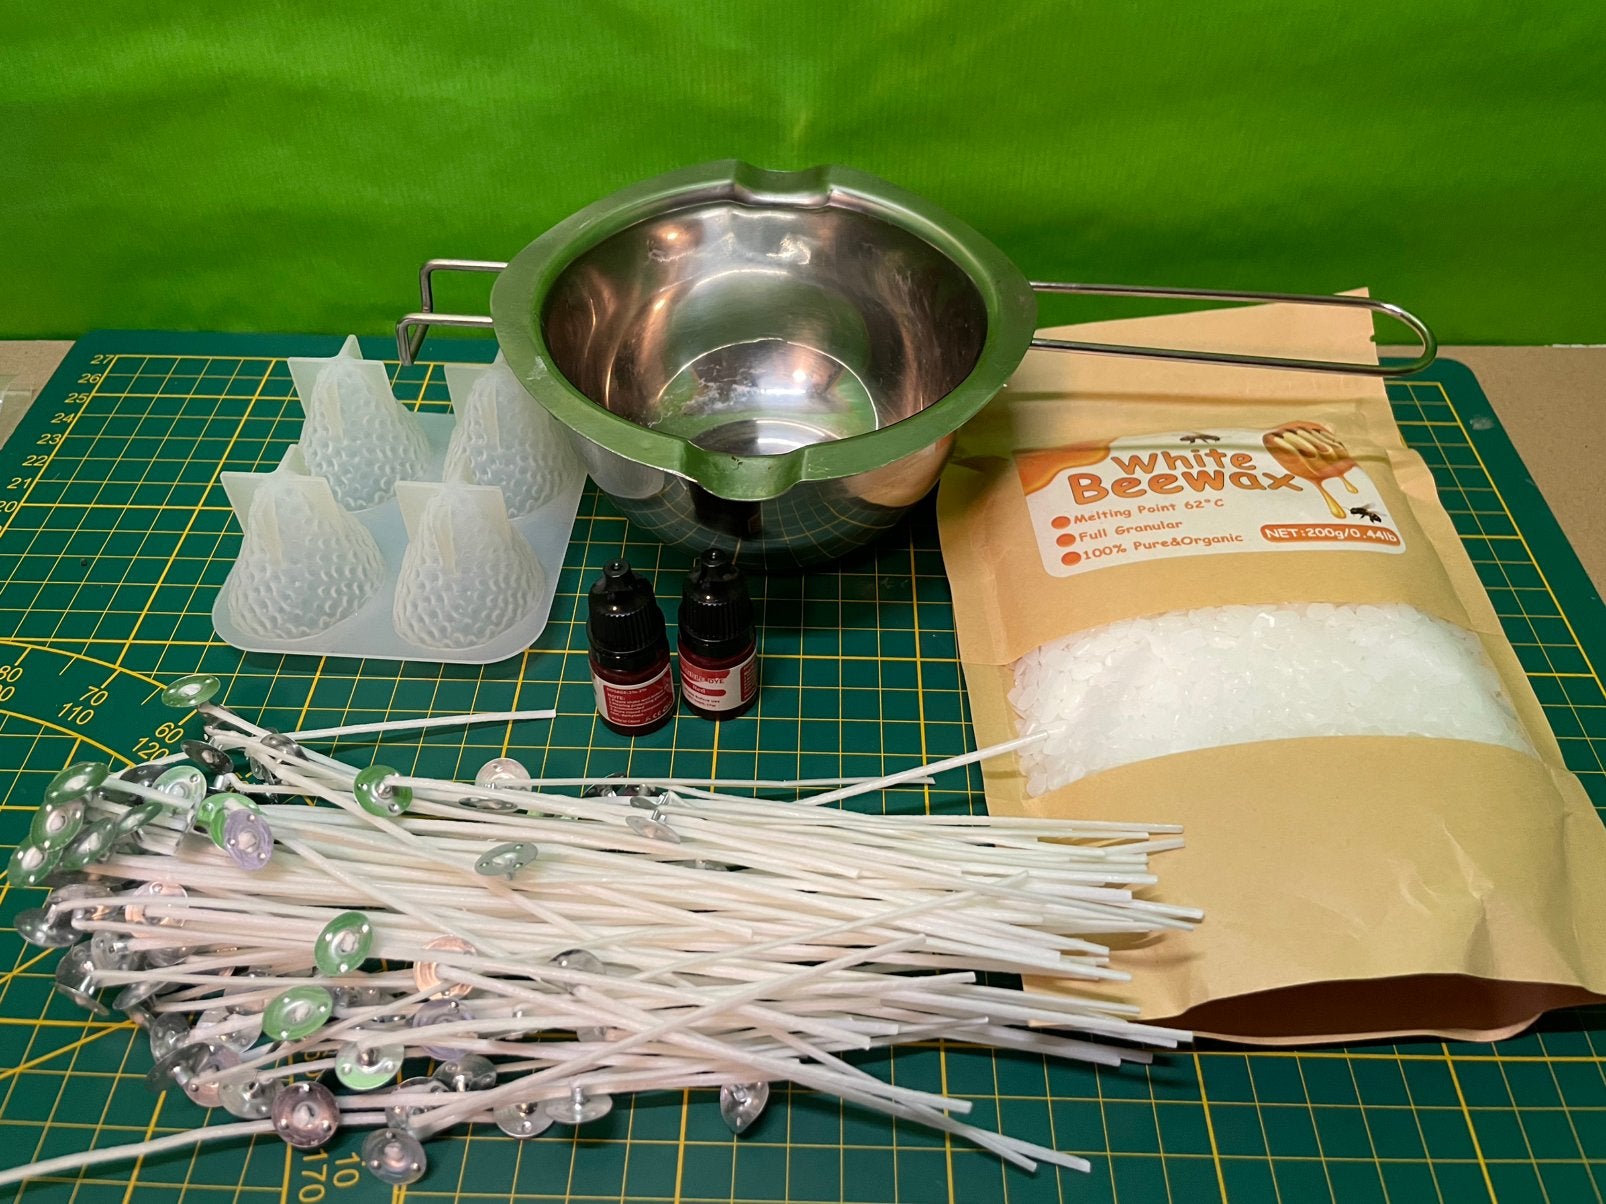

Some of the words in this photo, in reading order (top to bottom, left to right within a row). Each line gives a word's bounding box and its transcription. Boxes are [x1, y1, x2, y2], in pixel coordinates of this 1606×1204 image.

[90, 354, 115, 365] 27
[77, 373, 101, 384] 26
[64, 393, 89, 404] 25
[51, 413, 75, 424] 24
[36, 434, 62, 445] 23
[22, 455, 48, 467] 22
[1110, 448, 1257, 476] White
[7, 477, 32, 489] 21
[1067, 469, 1304, 506] Beewax
[1073, 508, 1132, 525] Melting
[1138, 503, 1177, 514] Point
[1078, 528, 1108, 543] Full
[1114, 520, 1184, 536] Granular
[1083, 543, 1127, 561] 100%
[1133, 533, 1244, 551] Pure&Organic
[79, 685, 109, 706] 70
[58, 702, 94, 725] 110
[155, 722, 184, 744] 60
[299, 1149, 328, 1202] 170
[333, 1152, 360, 1187] 10
